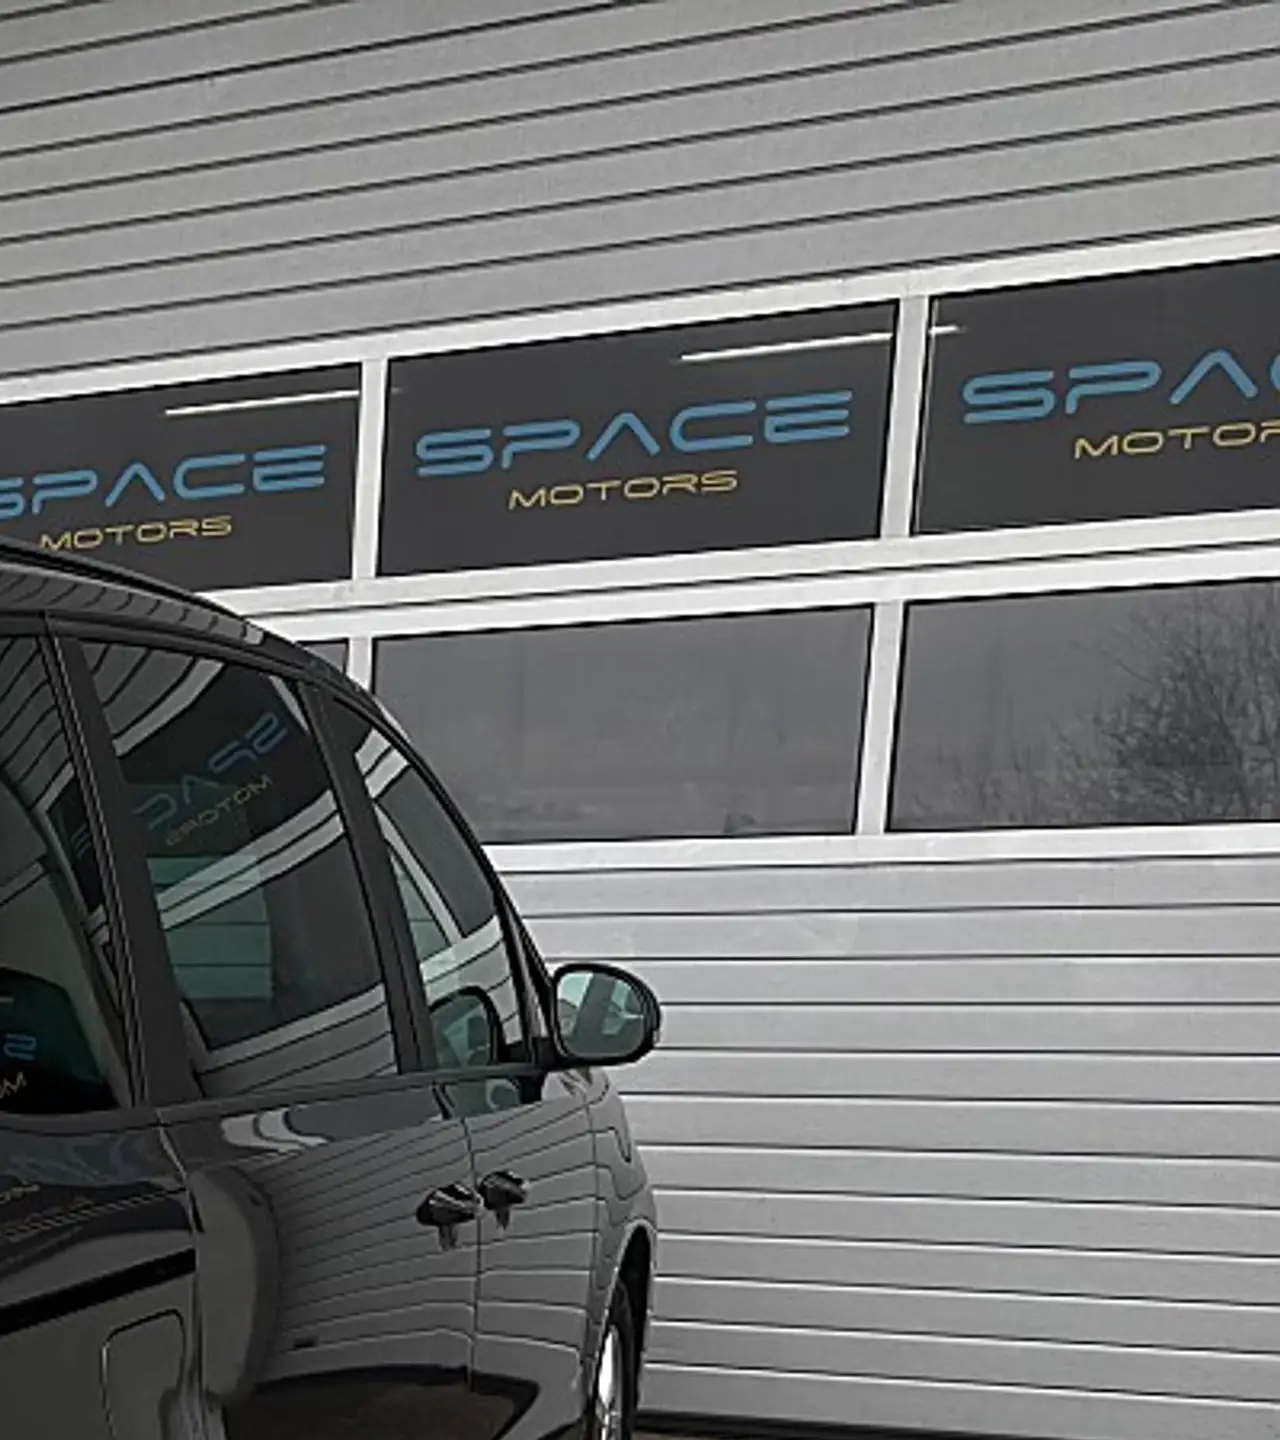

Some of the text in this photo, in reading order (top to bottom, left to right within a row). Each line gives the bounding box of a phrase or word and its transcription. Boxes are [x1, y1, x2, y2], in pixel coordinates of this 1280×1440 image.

[415, 389, 853, 477] SPACE
[508, 469, 739, 511] MOTORS
[40, 515, 233, 552] MOTORS
